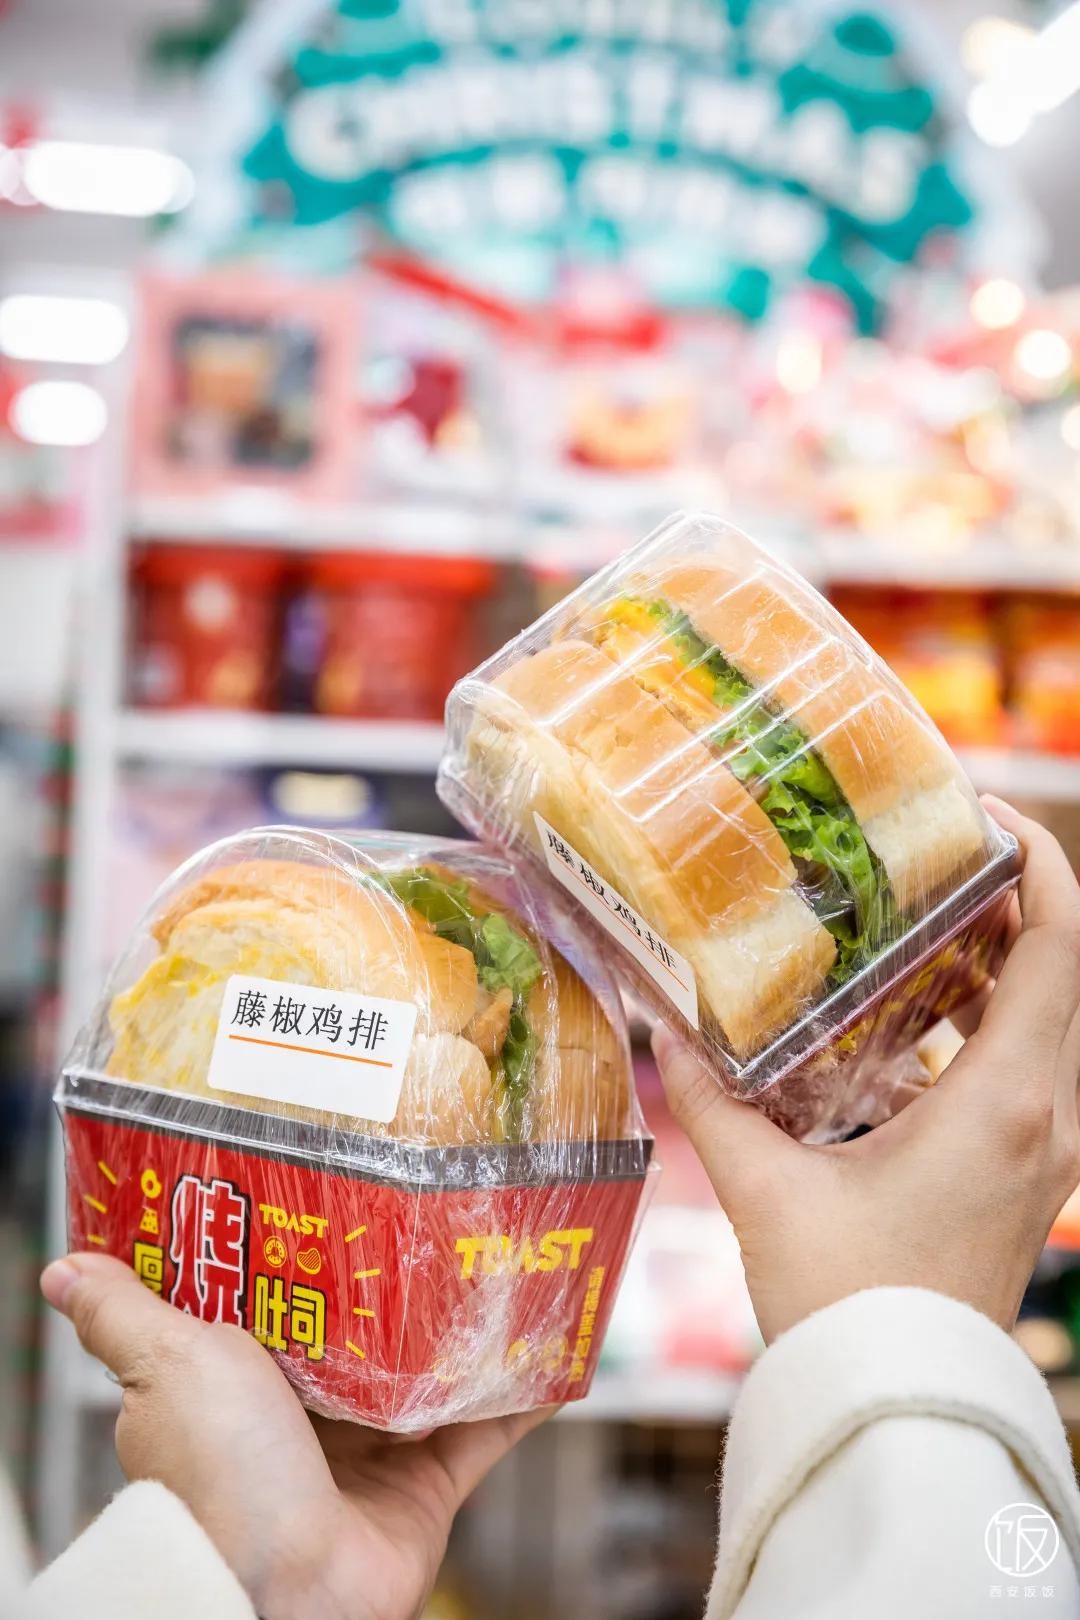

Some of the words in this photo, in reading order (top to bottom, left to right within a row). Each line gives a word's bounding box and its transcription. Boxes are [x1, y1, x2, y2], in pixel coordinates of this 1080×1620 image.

[231, 990, 389, 1050] 藤椒鸡排
[259, 1204, 329, 1239] TOAST
[454, 1227, 594, 1280] TOAST
[254, 1275, 326, 1361] 吐司
